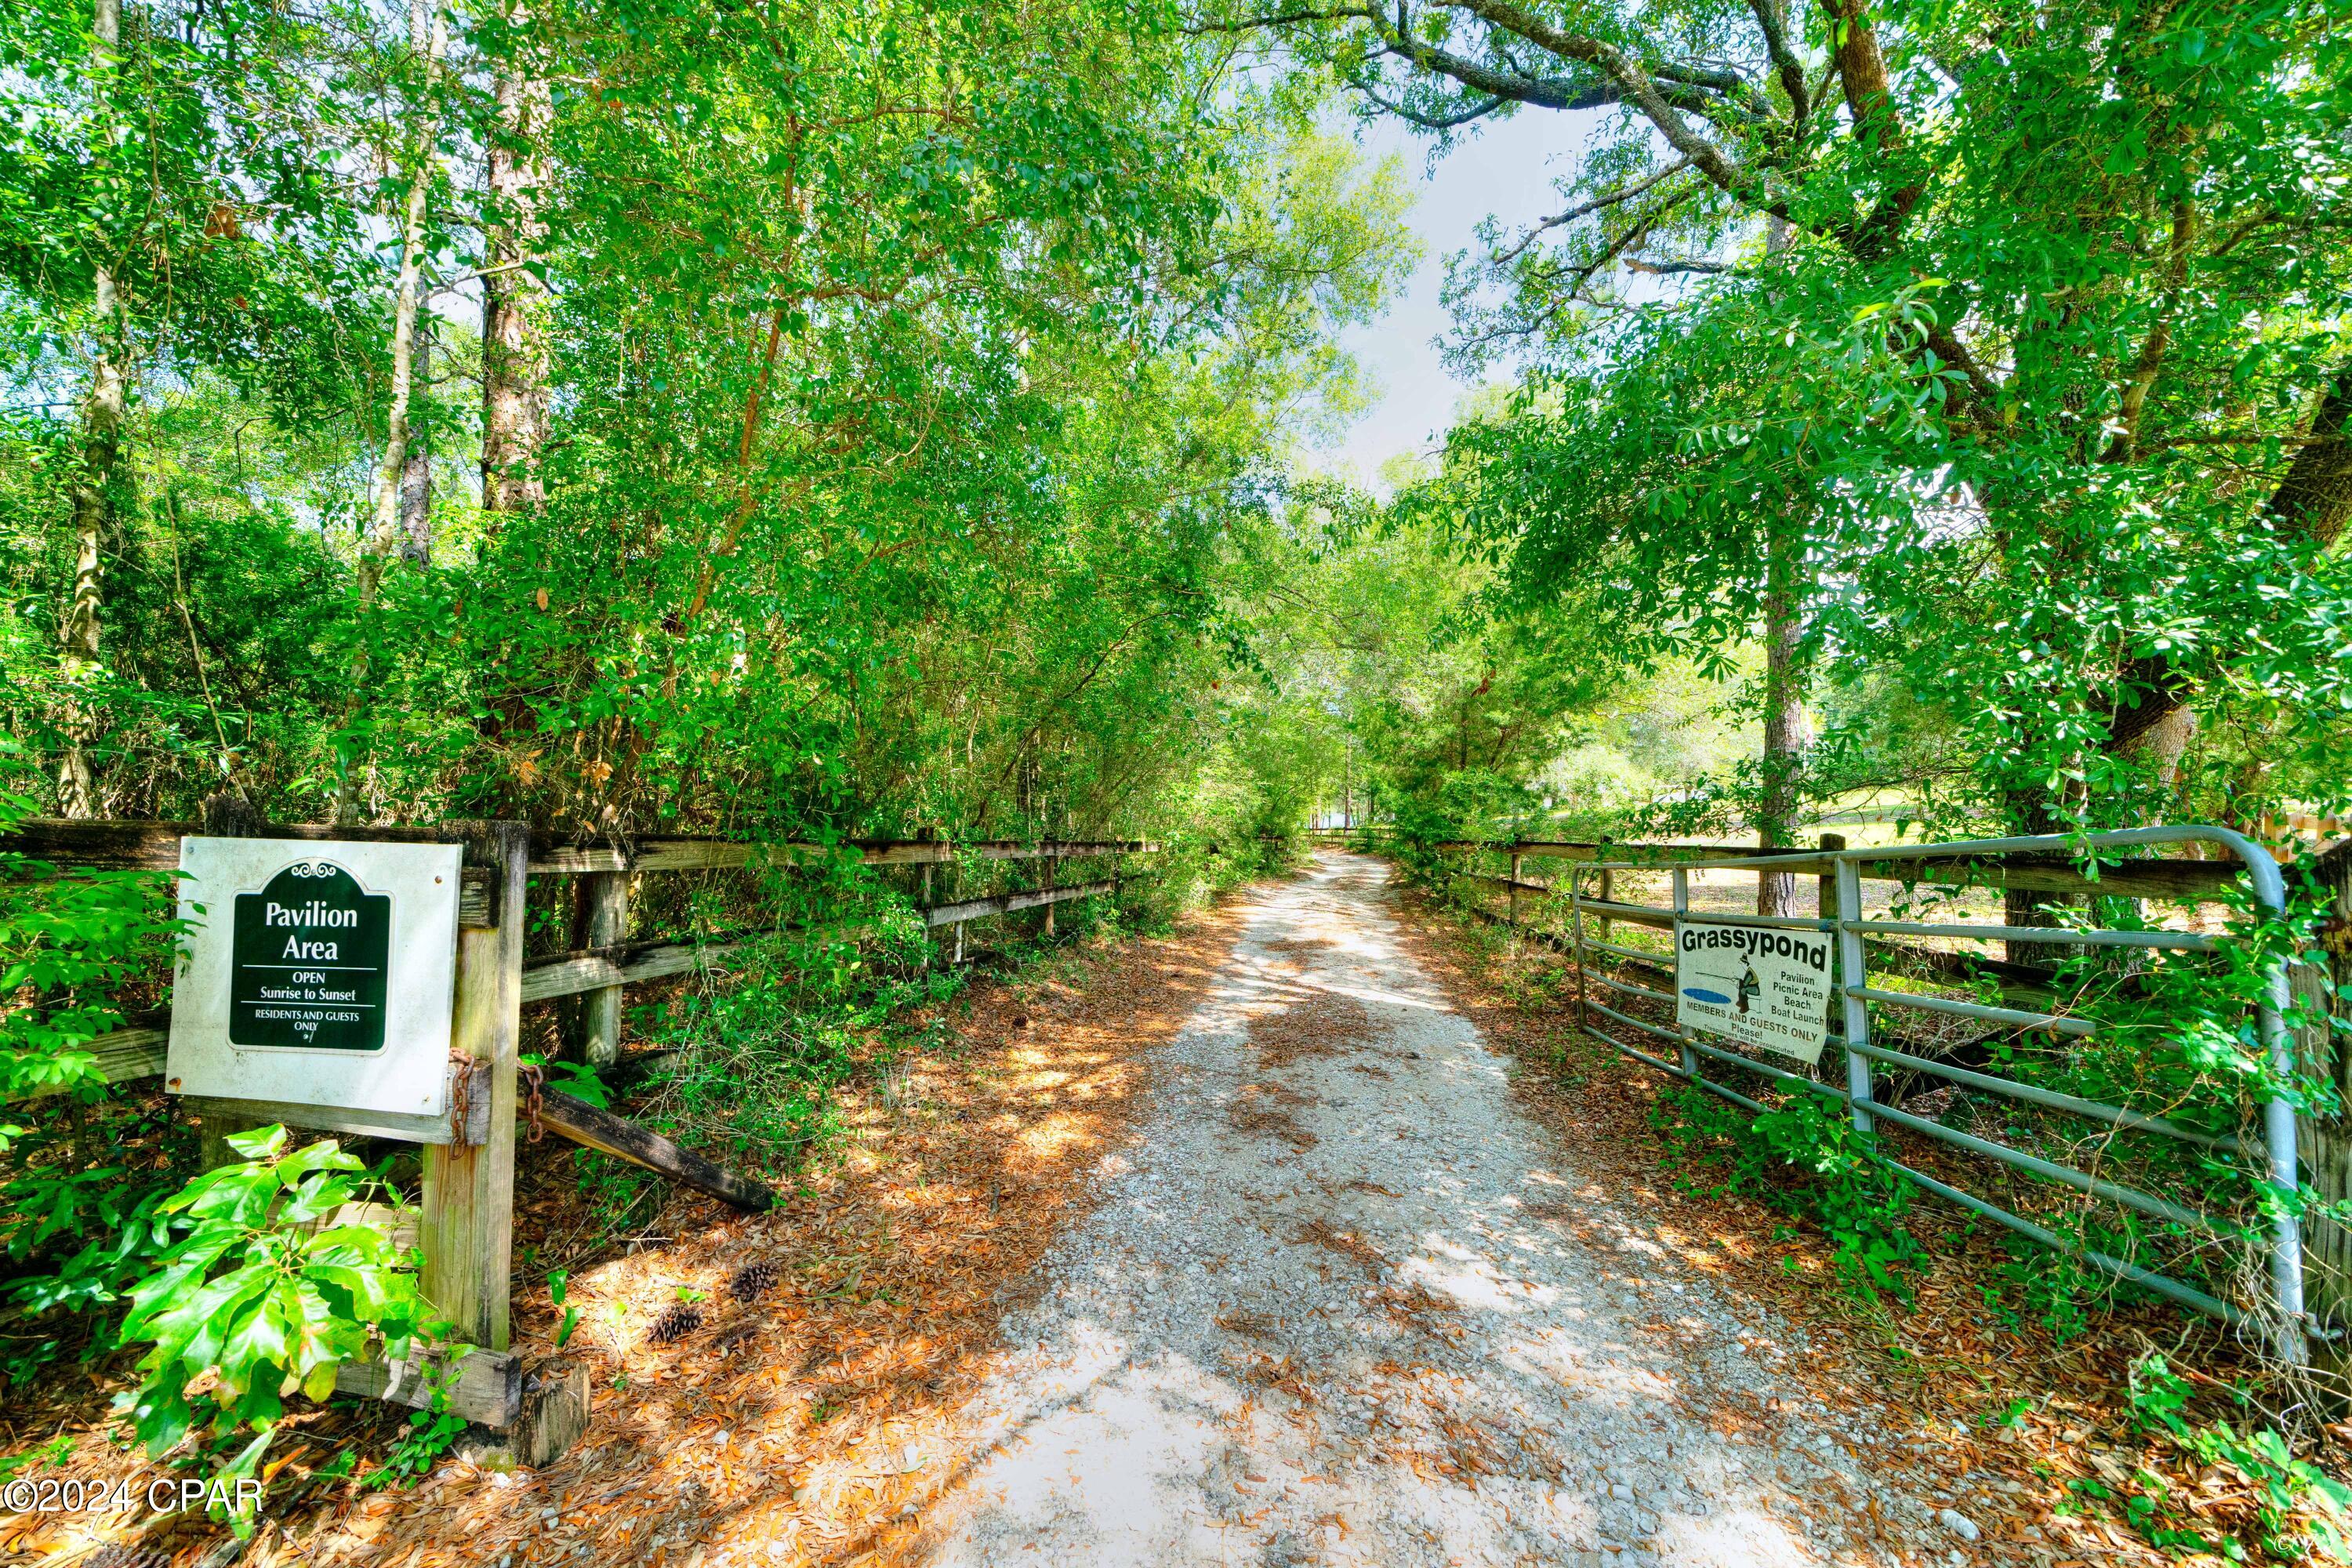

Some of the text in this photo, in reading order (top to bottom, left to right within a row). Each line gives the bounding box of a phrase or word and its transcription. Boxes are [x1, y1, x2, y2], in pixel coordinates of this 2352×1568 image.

[266, 901, 358, 927] Pavilion
[282, 935, 338, 960] Area
[1682, 929, 1827, 972] Grassypond
[292, 971, 325, 984] OPEN
[1780, 971, 1815, 985] Pavilion
[260, 986, 356, 1001] Sunrise to Sunset
[1773, 982, 1823, 1000] Picnic Area
[1784, 996, 1811, 1010] Beach
[255, 1010, 359, 1022] RESIDENTS AND GUESTS
[1686, 1001, 1818, 1043] MEMBERS AND GUESTS ONLY
[1771, 1005, 1824, 1026] Boat Launch
[294, 1021, 318, 1031] ONLY
[1731, 1023, 1763, 1040] Please!
[1704, 1024, 1738, 1039] Trespassers
[1739, 1034, 1749, 1043] will
[1759, 1040, 1795, 1055] prosecuted
